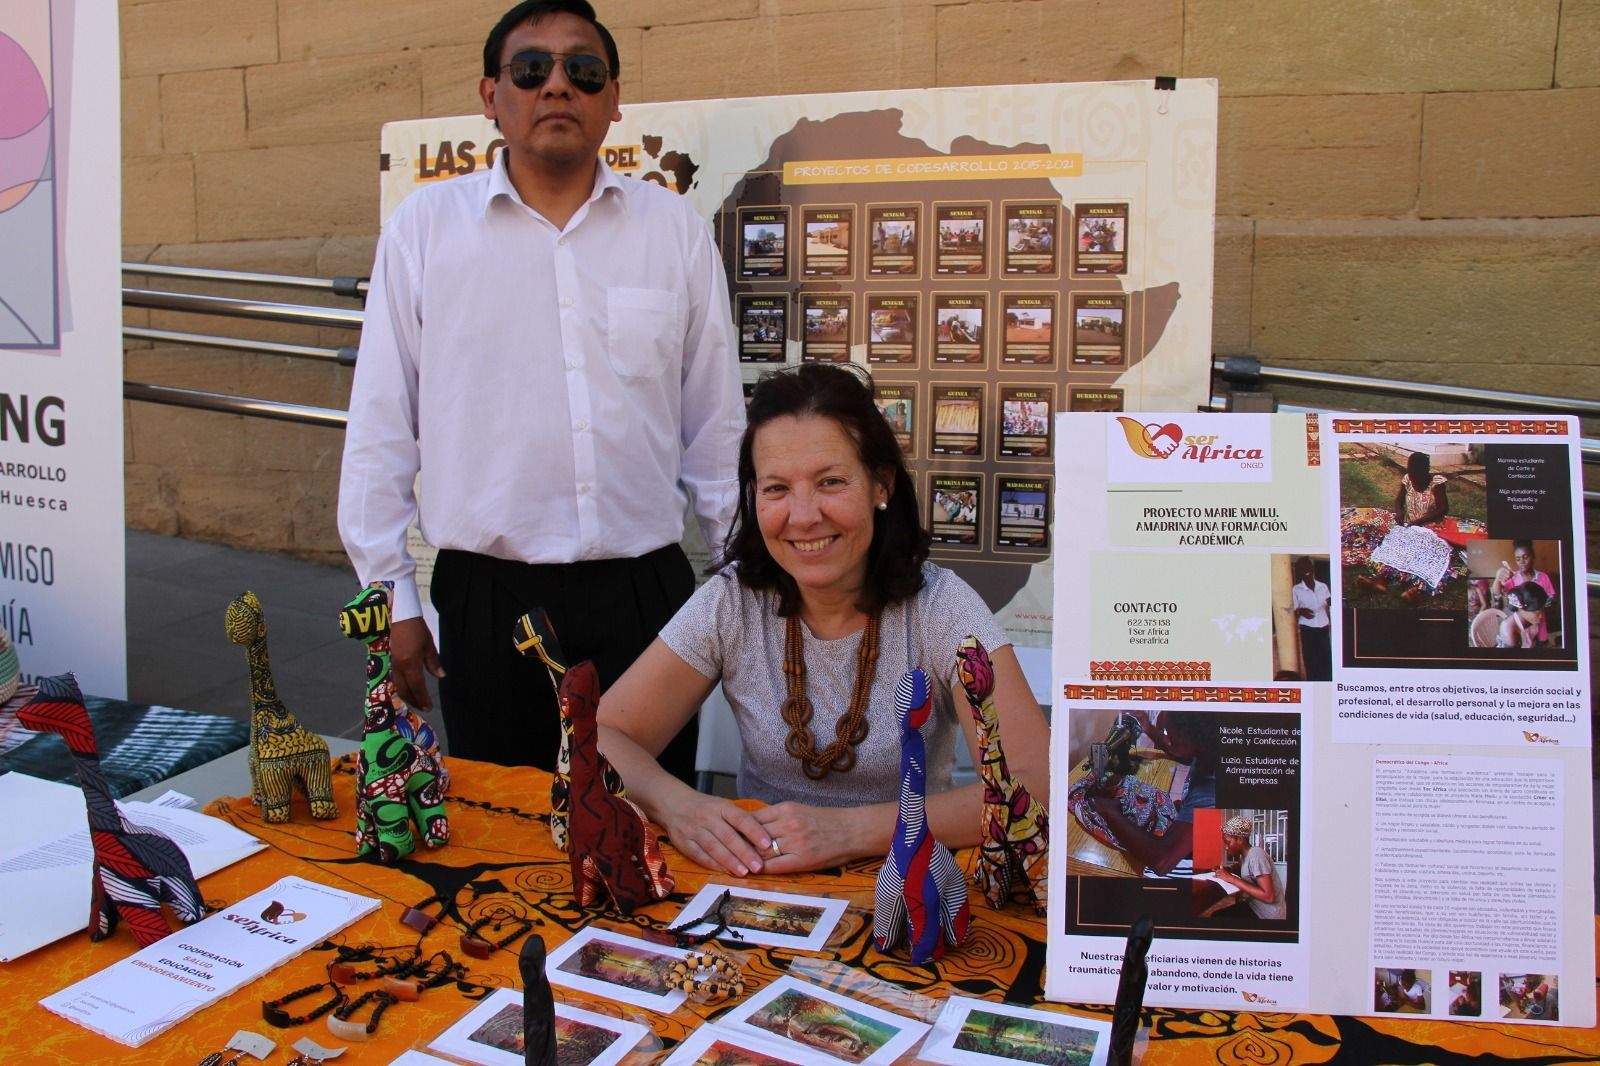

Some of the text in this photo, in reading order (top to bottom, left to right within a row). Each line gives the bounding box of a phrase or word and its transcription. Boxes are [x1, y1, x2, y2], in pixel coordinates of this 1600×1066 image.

[419, 140, 476, 178] LAS
[606, 147, 637, 167] DEL
[794, 158, 1074, 177] PROYECTOS DE CODESARROLLO 2015-2021
[1184, 434, 1219, 446] ser
[1182, 444, 1264, 463] Africa
[0, 490, 67, 511] Huesca
[1143, 507, 1279, 518] PROYECTO MARIE MWILU.
[1136, 519, 1288, 532] AMADRINA UNA FORMACIÓN
[1179, 533, 1245, 546] ACADÉMICA
[1113, 602, 1178, 613] CONTACTO
[1127, 618, 1142, 627] 622
[1133, 628, 1145, 636] Ser
[1337, 683, 1582, 697] Buscamos, entre otros objetivos, la inserción social y
[1338, 697, 1394, 707] profesional,
[1395, 697, 1404, 706] el
[1406, 698, 1455, 707] desarrollo
[1456, 699, 1497, 708] personal
[1499, 700, 1505, 709] y
[1506, 699, 1516, 708] la
[1517, 700, 1551, 710] mejora
[1566, 700, 1581, 709] las
[1338, 710, 1577, 724] condiciones de vida (salud, educación, seguridad...)
[1247, 726, 1289, 736] Estudiante
[1291, 727, 1301, 736] de
[1221, 736, 1297, 746] Corte y Confección
[1245, 756, 1287, 765] Estudiante
[1289, 757, 1300, 766] de
[1225, 766, 1295, 775] Administración de
[1239, 776, 1278, 786] Empresas
[178, 943, 245, 969] COOPERACIÓN
[182, 955, 214, 969] SALUD
[1080, 951, 1282, 968] Nuestras eficiarias vienen de historias
[158, 957, 214, 980] EDUCACIÓN
[1068, 964, 1294, 982] traumática abandono, donde la vida tiene
[131, 959, 216, 993] EMPODERAMIENTO
[1147, 982, 1238, 995] valor y motivación.
